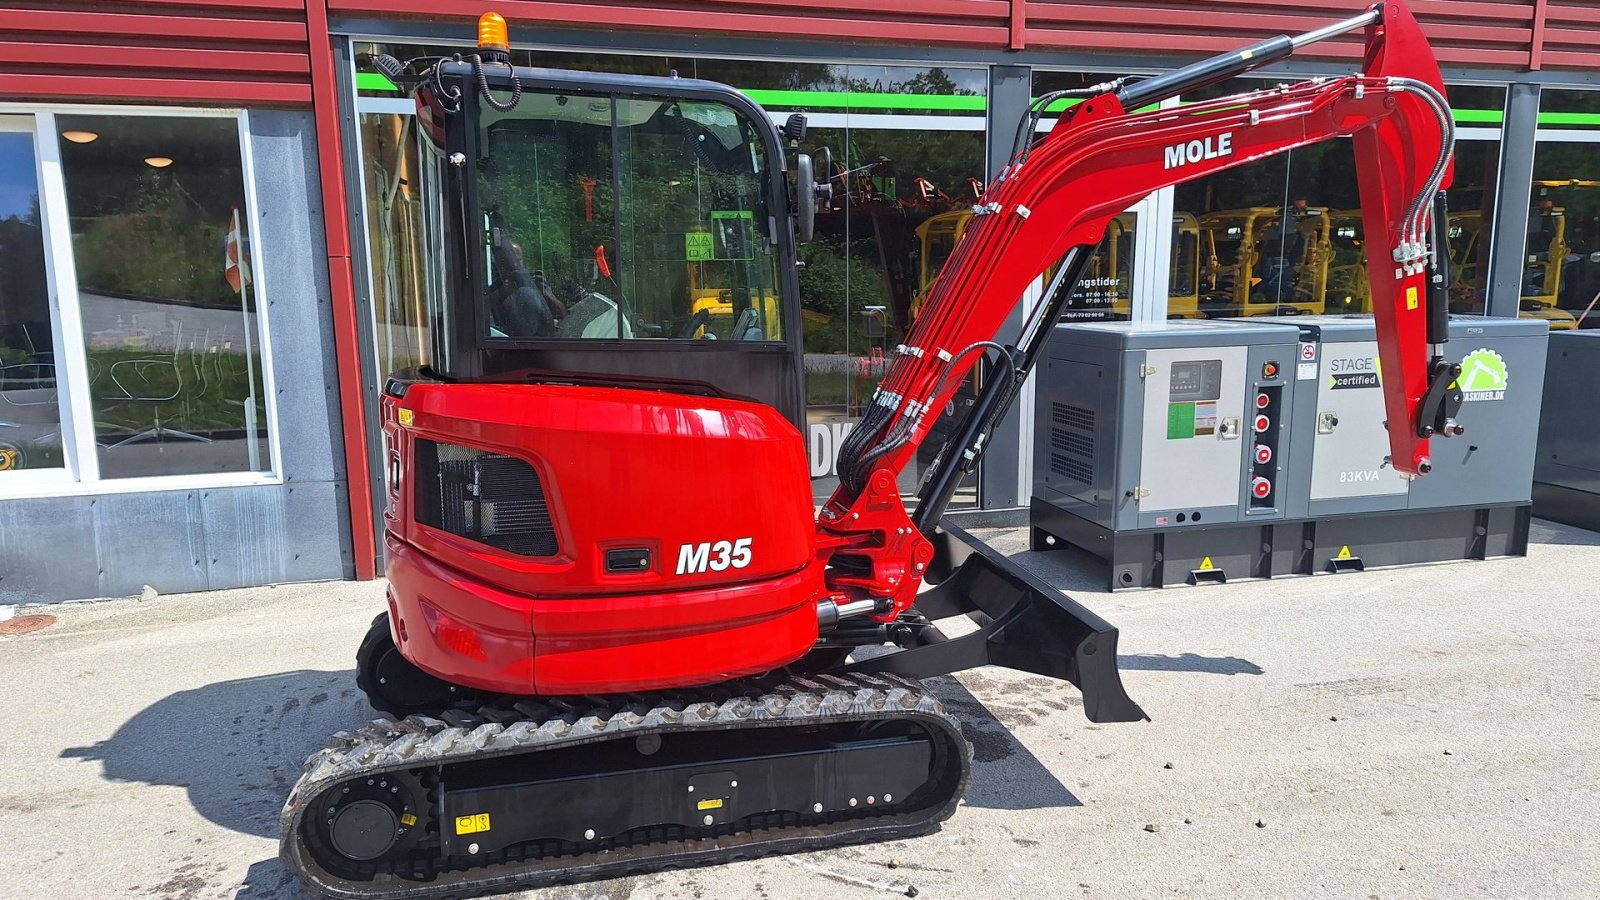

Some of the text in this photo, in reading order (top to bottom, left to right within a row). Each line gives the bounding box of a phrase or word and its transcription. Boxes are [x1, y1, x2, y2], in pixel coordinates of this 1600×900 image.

[1164, 132, 1233, 170] MOLE
[1331, 358, 1372, 371] STAGE
[1337, 375, 1376, 386] certified
[1340, 470, 1379, 482] 83KVA
[676, 537, 752, 575] M35
